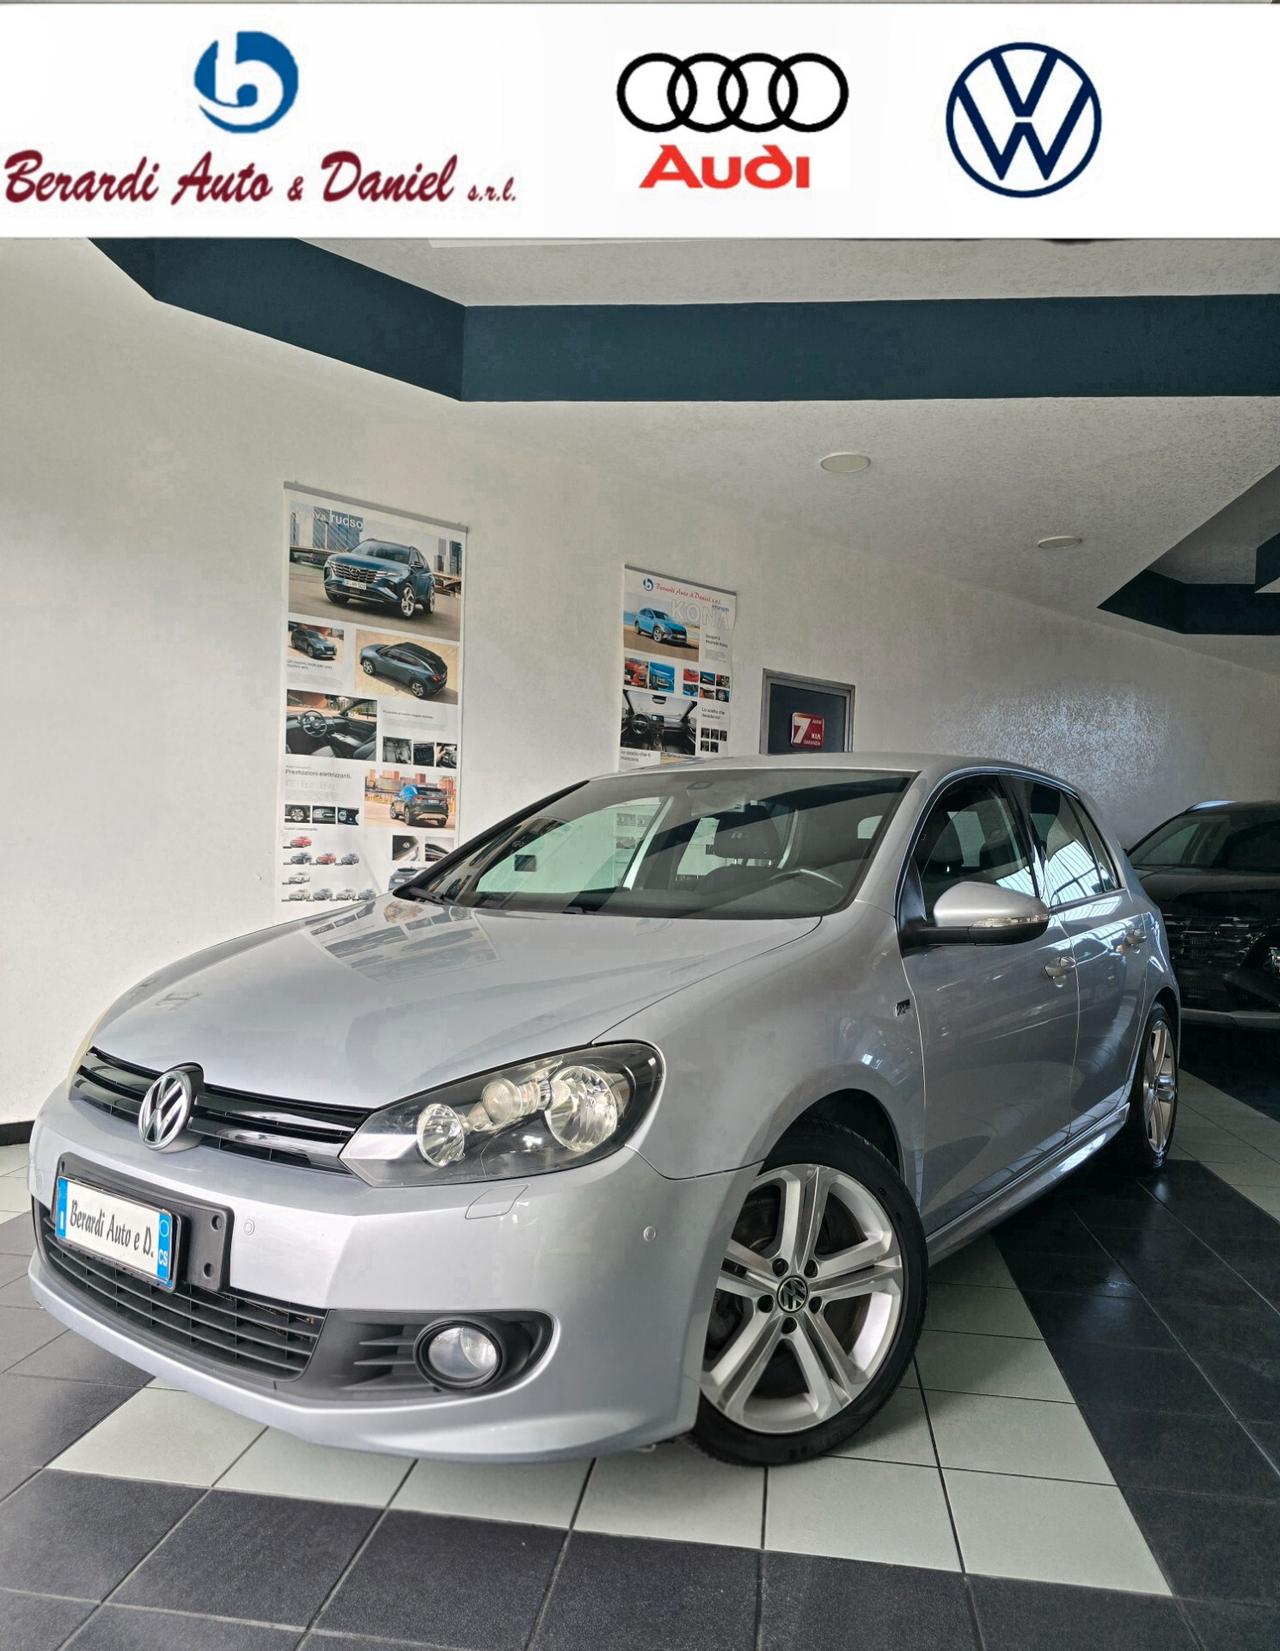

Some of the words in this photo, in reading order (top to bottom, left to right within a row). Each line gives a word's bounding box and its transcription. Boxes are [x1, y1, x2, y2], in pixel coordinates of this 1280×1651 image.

[671, 599, 732, 631] KONA
[793, 716, 812, 744] 7
[69, 1199, 106, 1238] Berardi
[106, 1213, 132, 1247] Auto
[133, 1231, 140, 1252] e
[142, 1225, 155, 1259] D.
